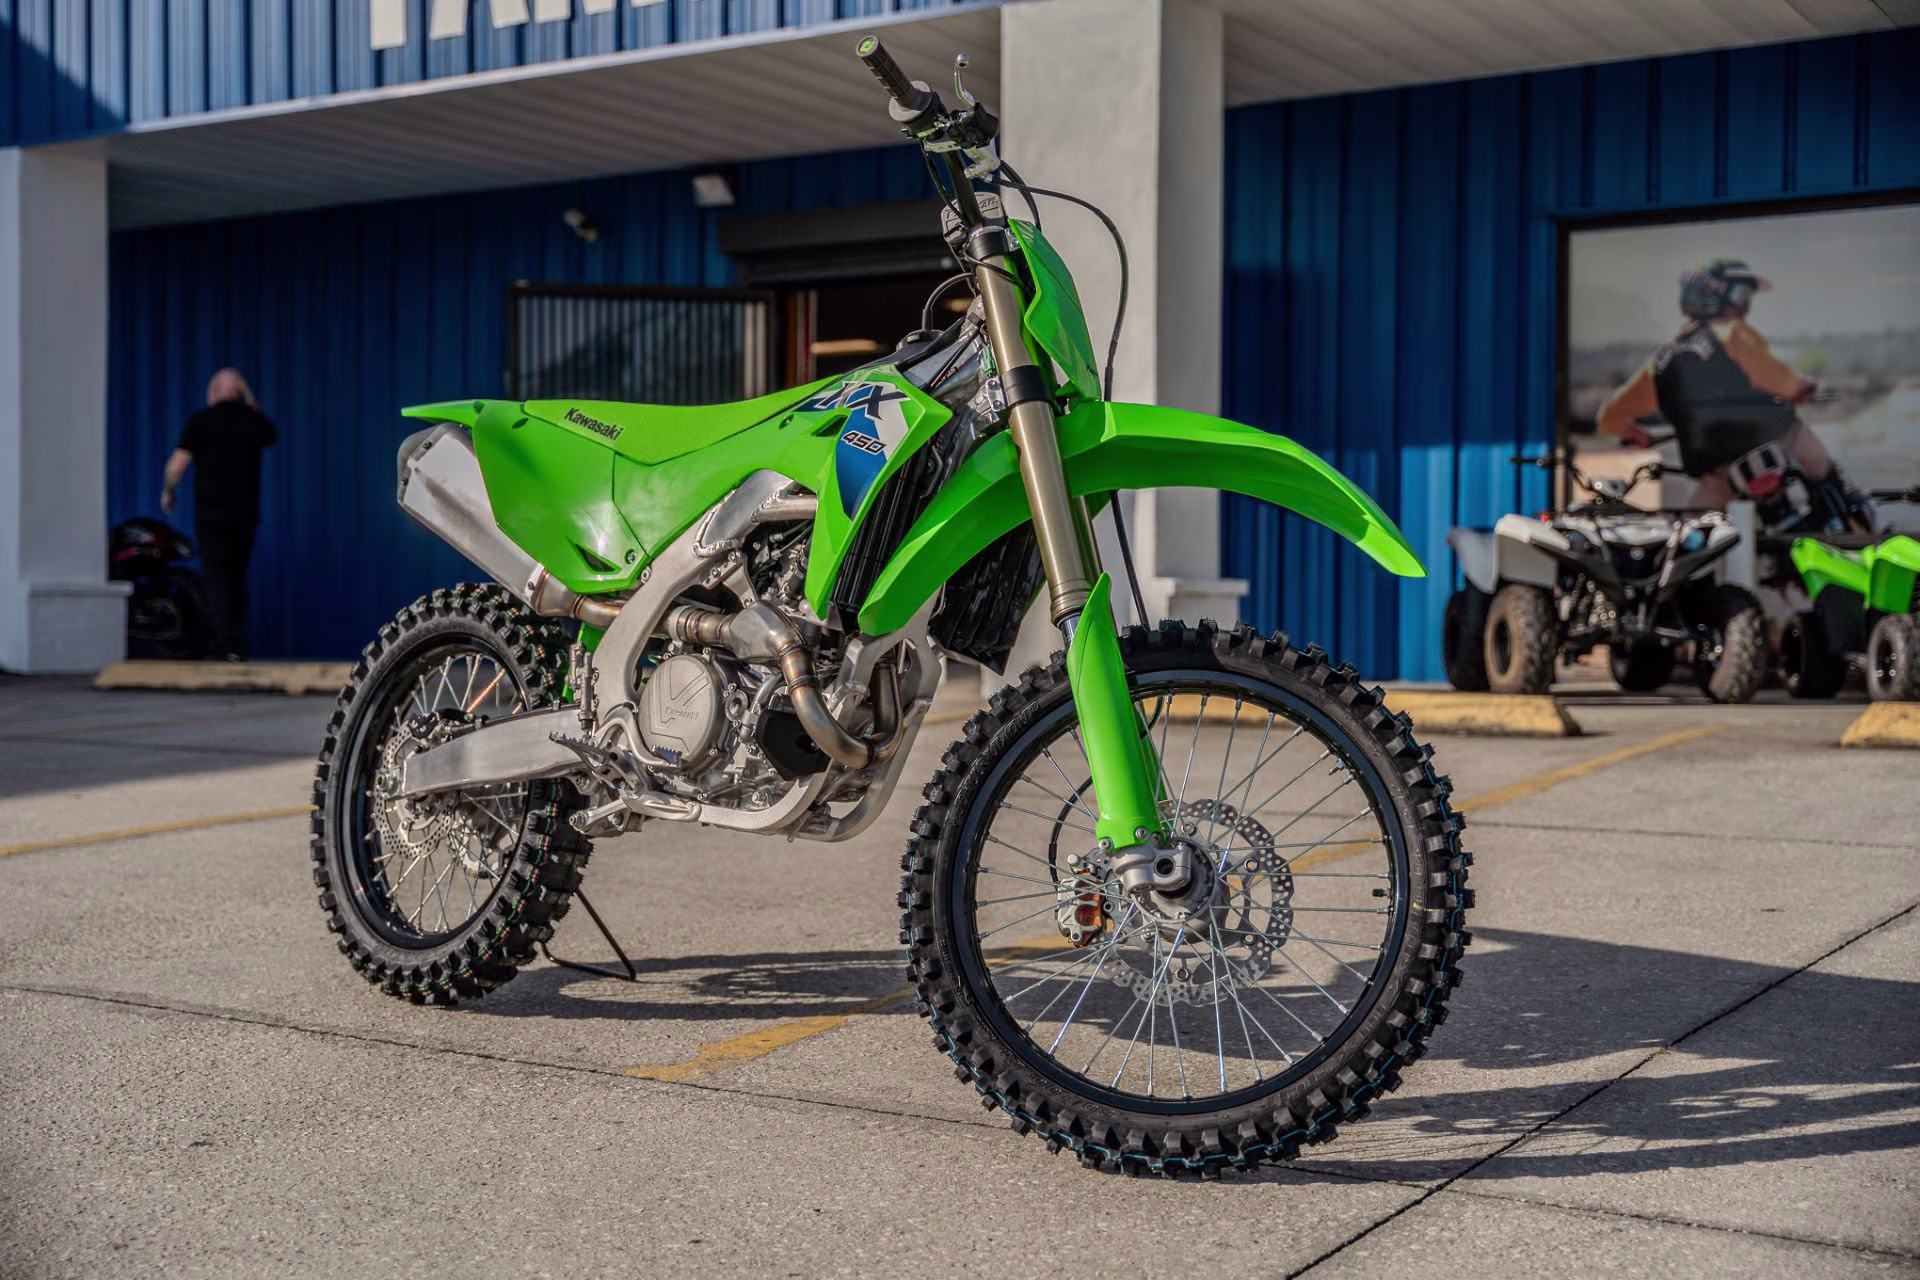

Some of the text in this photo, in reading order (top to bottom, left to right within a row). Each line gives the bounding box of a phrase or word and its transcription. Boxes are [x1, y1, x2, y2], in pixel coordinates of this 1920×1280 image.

[814, 381, 912, 421] KX
[564, 407, 624, 441] Kawasaki
[841, 430, 887, 455] 450
